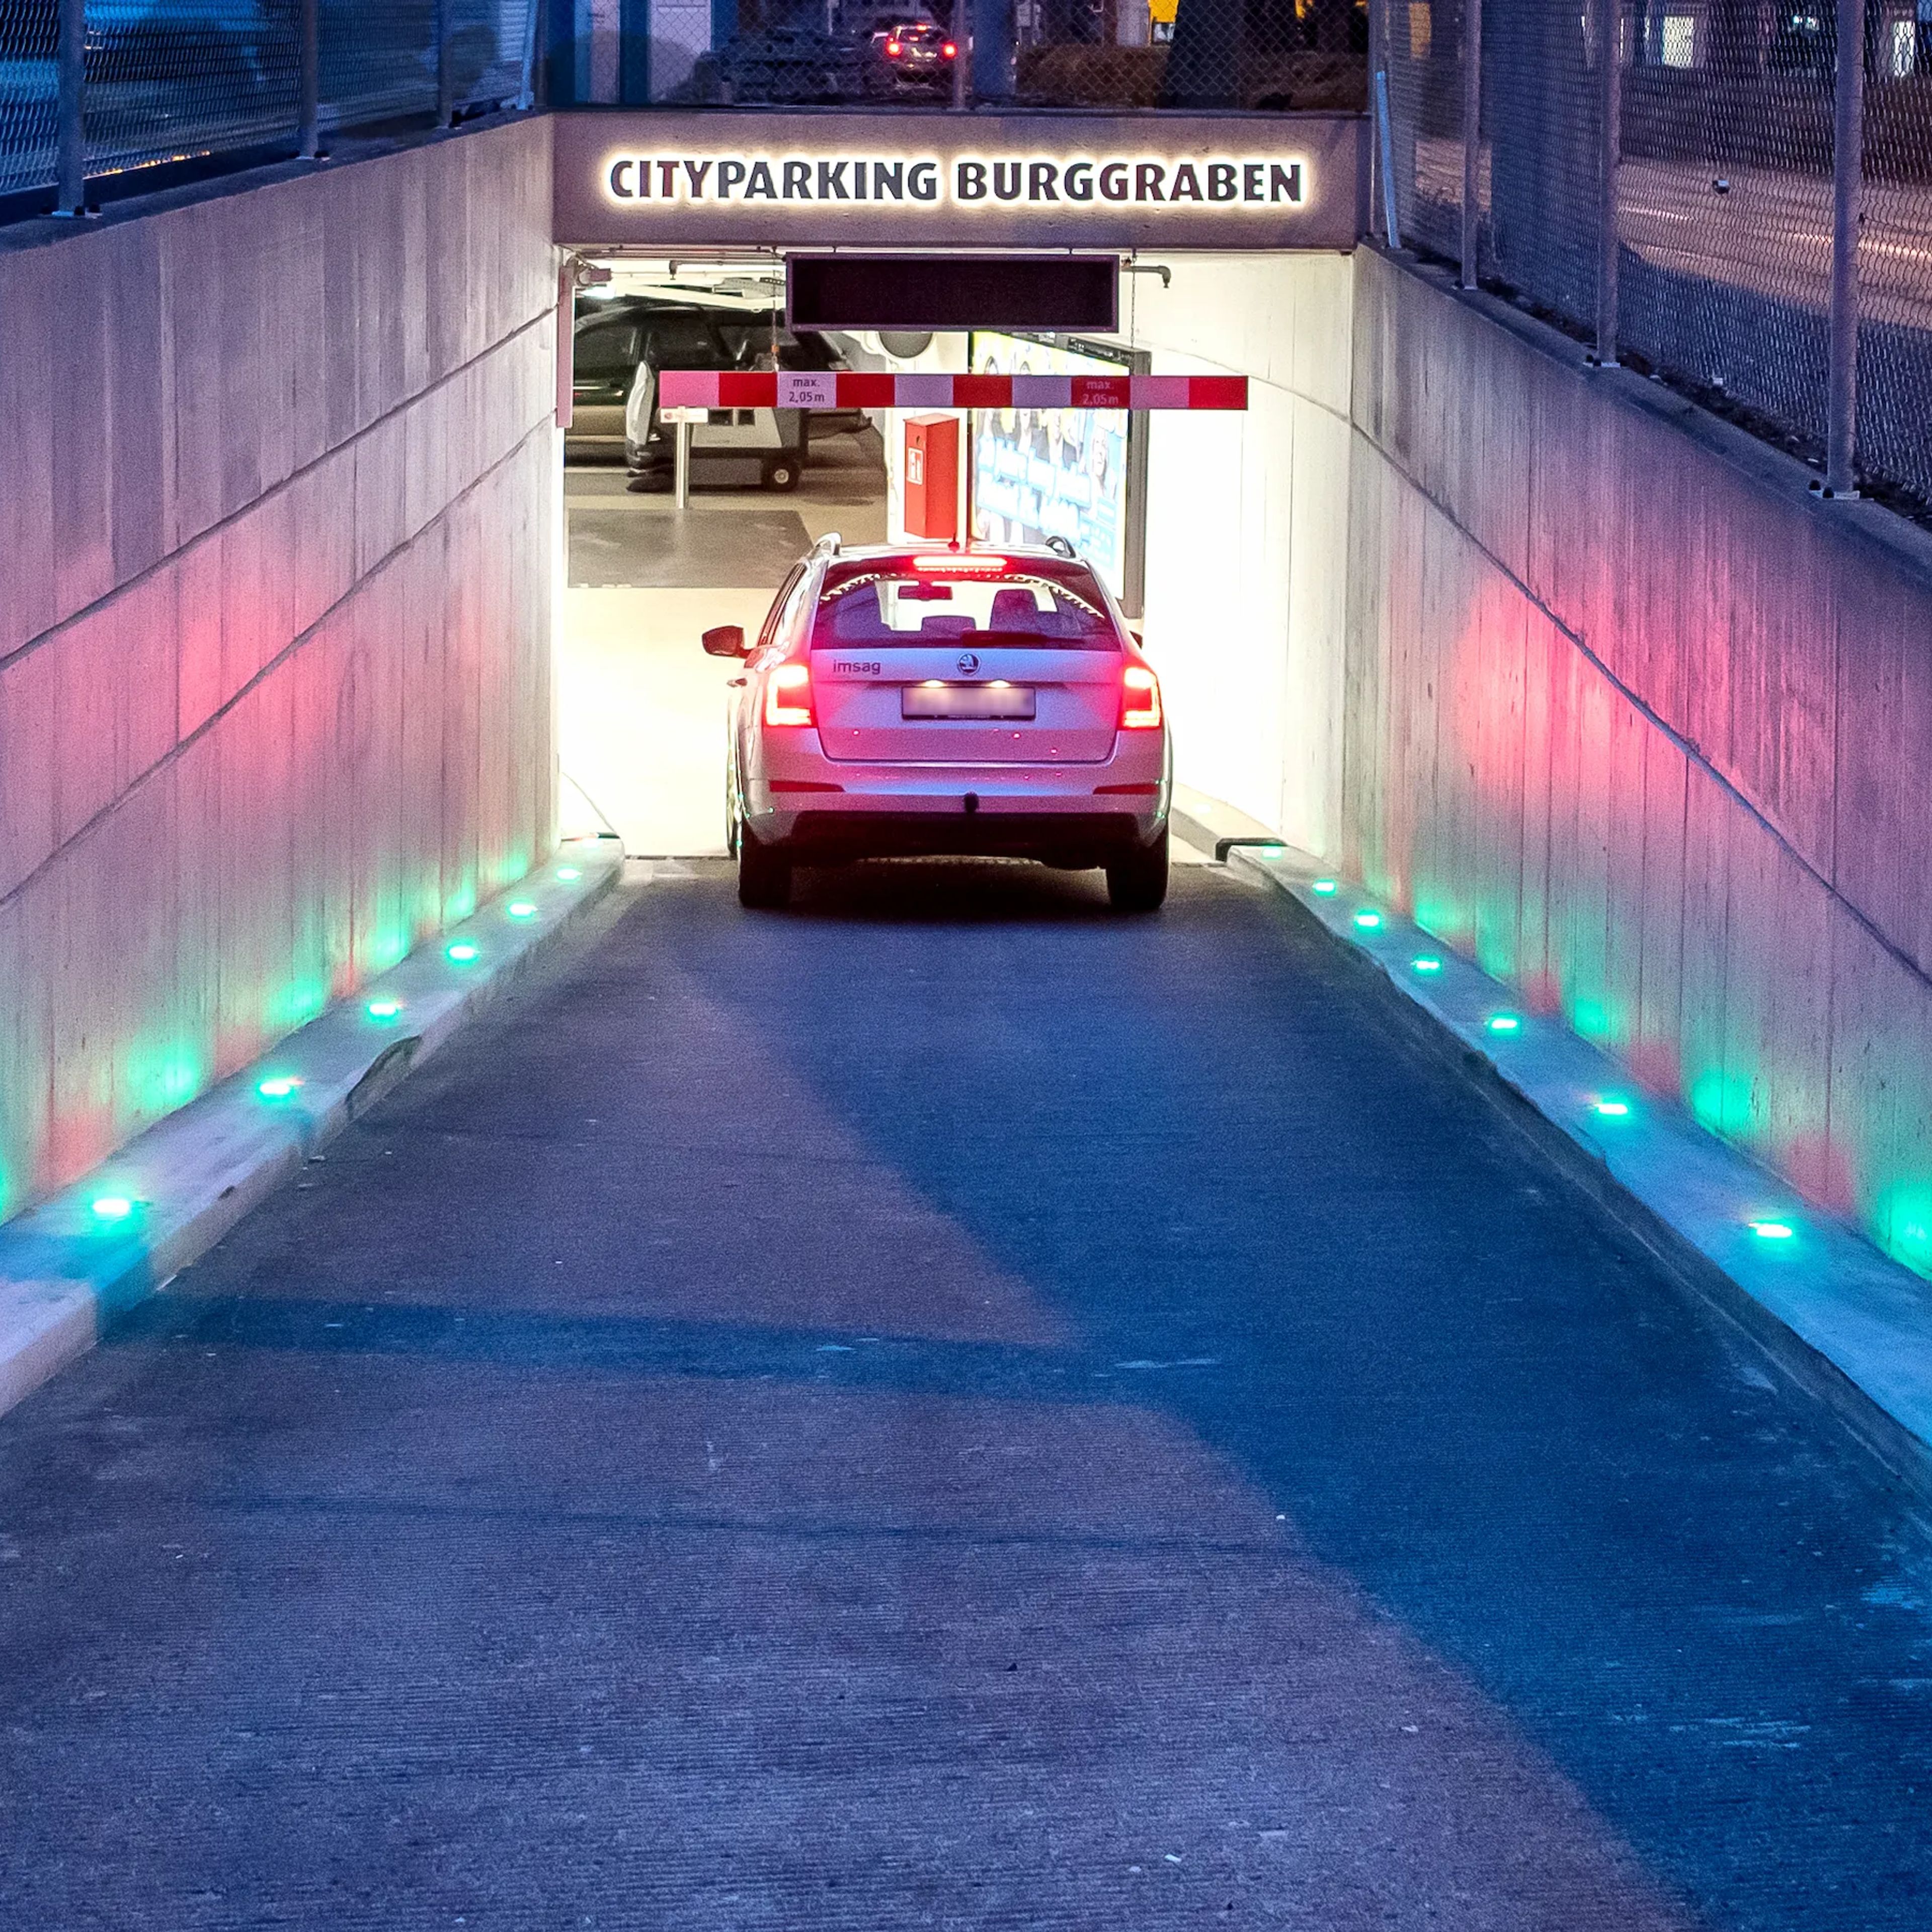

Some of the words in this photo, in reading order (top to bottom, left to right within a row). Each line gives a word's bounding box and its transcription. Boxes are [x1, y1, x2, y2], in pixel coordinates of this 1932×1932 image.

[610, 160, 937, 200] CITYPARKING
[957, 162, 1301, 202] BURGGRABEN
[793, 379, 820, 387] max.
[1087, 381, 1114, 389] max.
[833, 659, 881, 675] imsag
